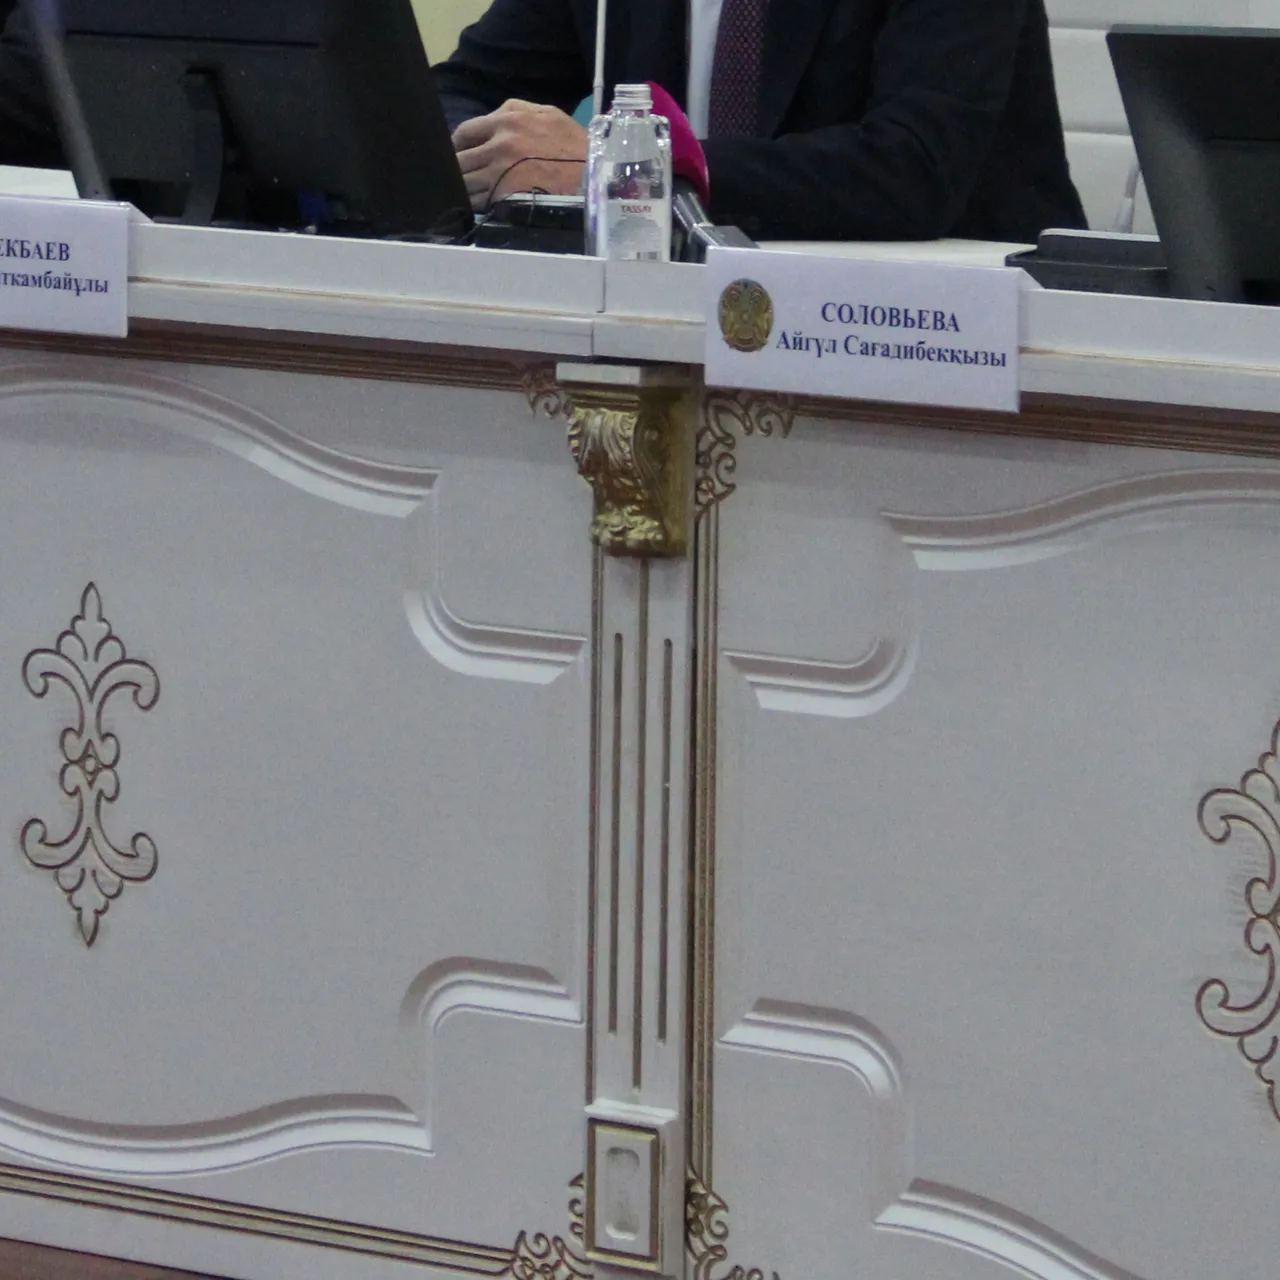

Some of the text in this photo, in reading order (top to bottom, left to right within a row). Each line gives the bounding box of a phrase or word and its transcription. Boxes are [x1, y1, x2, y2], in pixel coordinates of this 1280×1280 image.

[821, 301, 961, 333] СОЛОВЬЕВА
[776, 330, 1007, 368] Айгүл Сағадибекқызы
